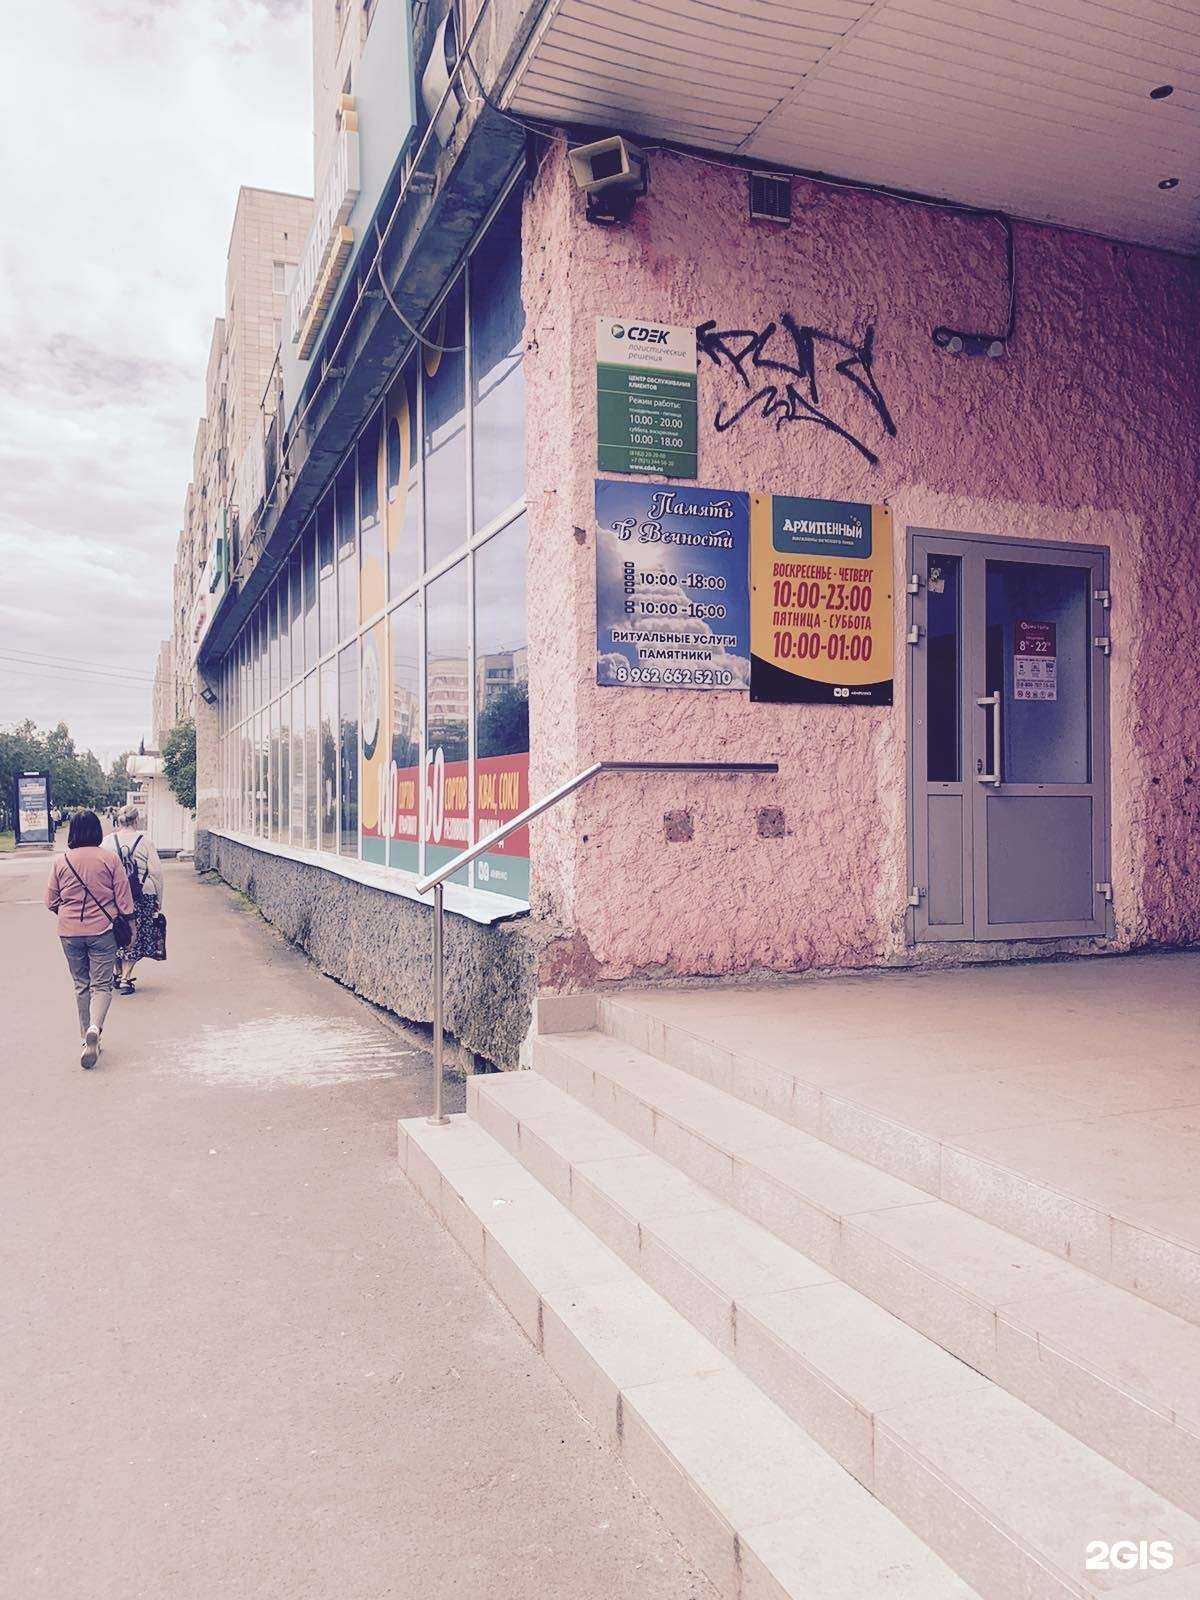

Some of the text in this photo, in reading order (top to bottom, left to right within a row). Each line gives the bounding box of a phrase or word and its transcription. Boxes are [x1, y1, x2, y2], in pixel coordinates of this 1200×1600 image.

[628, 327, 670, 344] CDEK
[628, 353, 663, 362] решения
[629, 396, 653, 406] Режим
[630, 415, 653, 425] 10.00
[660, 418, 683, 428] 20.00
[630, 434, 653, 444] 10.00
[661, 437, 684, 448] 18.00
[648, 492, 734, 519] Память
[639, 521, 734, 549] Вечности
[640, 573, 677, 585] 10:00
[773, 562, 832, 580] ВОСКРЕСЕНЬЕ
[839, 567, 874, 583] ЧЕТВЕРГ
[773, 580, 872, 611] 10:00-23:00
[640, 602, 677, 614] 10:00
[773, 611, 820, 628] ПЯТНИЦА
[829, 613, 872, 630] СУББОТА
[612, 631, 737, 647] РИТУАЛЬНЫЕ УСЛУГИ
[773, 631, 873, 662] 10:00-01:00
[639, 649, 712, 661] ПАМЯТНИКИ
[616, 667, 629, 682] 8
[630, 667, 660, 684] 962
[664, 668, 692, 684] 662
[499, 771, 520, 810] СОКИ
